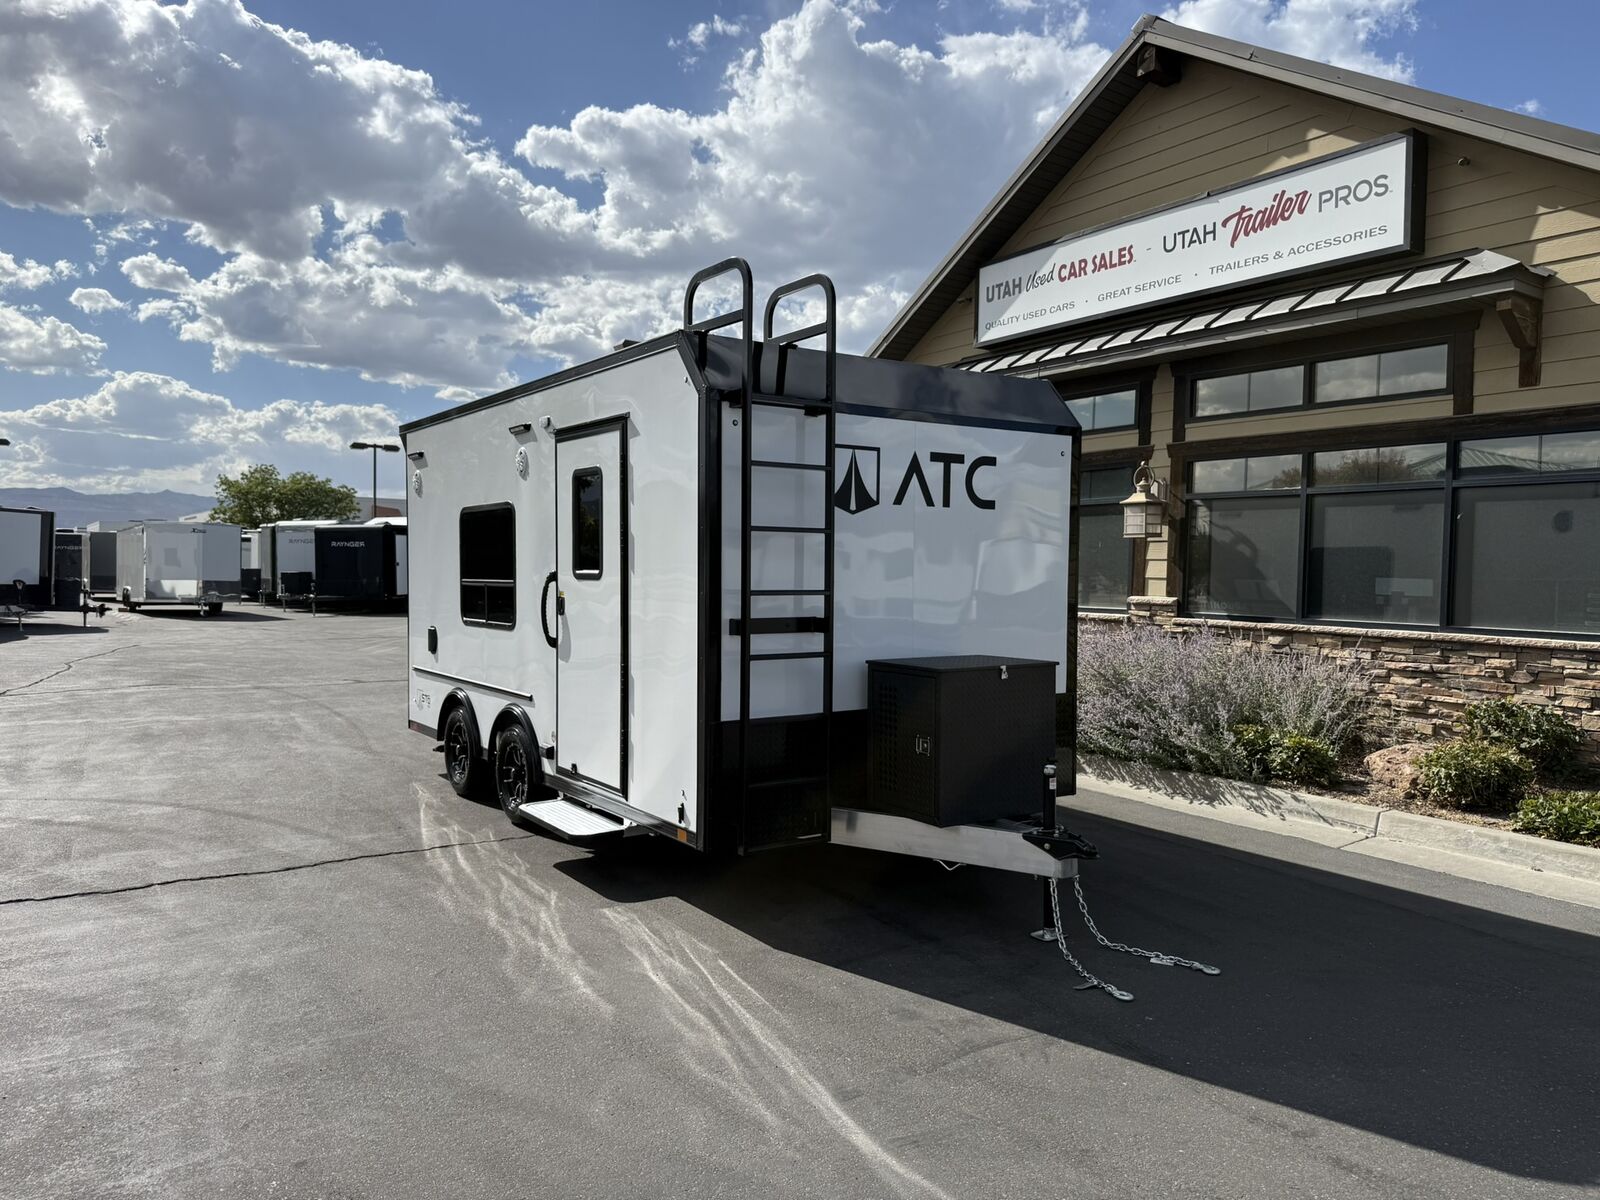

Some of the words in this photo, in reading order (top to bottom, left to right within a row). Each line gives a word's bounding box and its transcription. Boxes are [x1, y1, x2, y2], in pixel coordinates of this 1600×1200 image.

[985, 314, 1021, 331] QUALITY
[1022, 308, 1047, 320] USED
[1049, 301, 1076, 314] CARS
[1097, 286, 1132, 302] GREAT
[1134, 274, 1183, 293] SERVICE
[1209, 253, 1270, 275] TRAILERS
[1273, 250, 1284, 261] &
[1287, 225, 1389, 257] ACCESSORIES
[986, 277, 1022, 303] UTAH
[1025, 263, 1056, 292] Used
[1058, 258, 1088, 283] CAR
[1091, 244, 1134, 274] SALES
[1163, 222, 1217, 253] UTAH
[1221, 189, 1312, 248] Trailer
[1318, 174, 1390, 213] PROS
[892, 451, 998, 510] ATC
